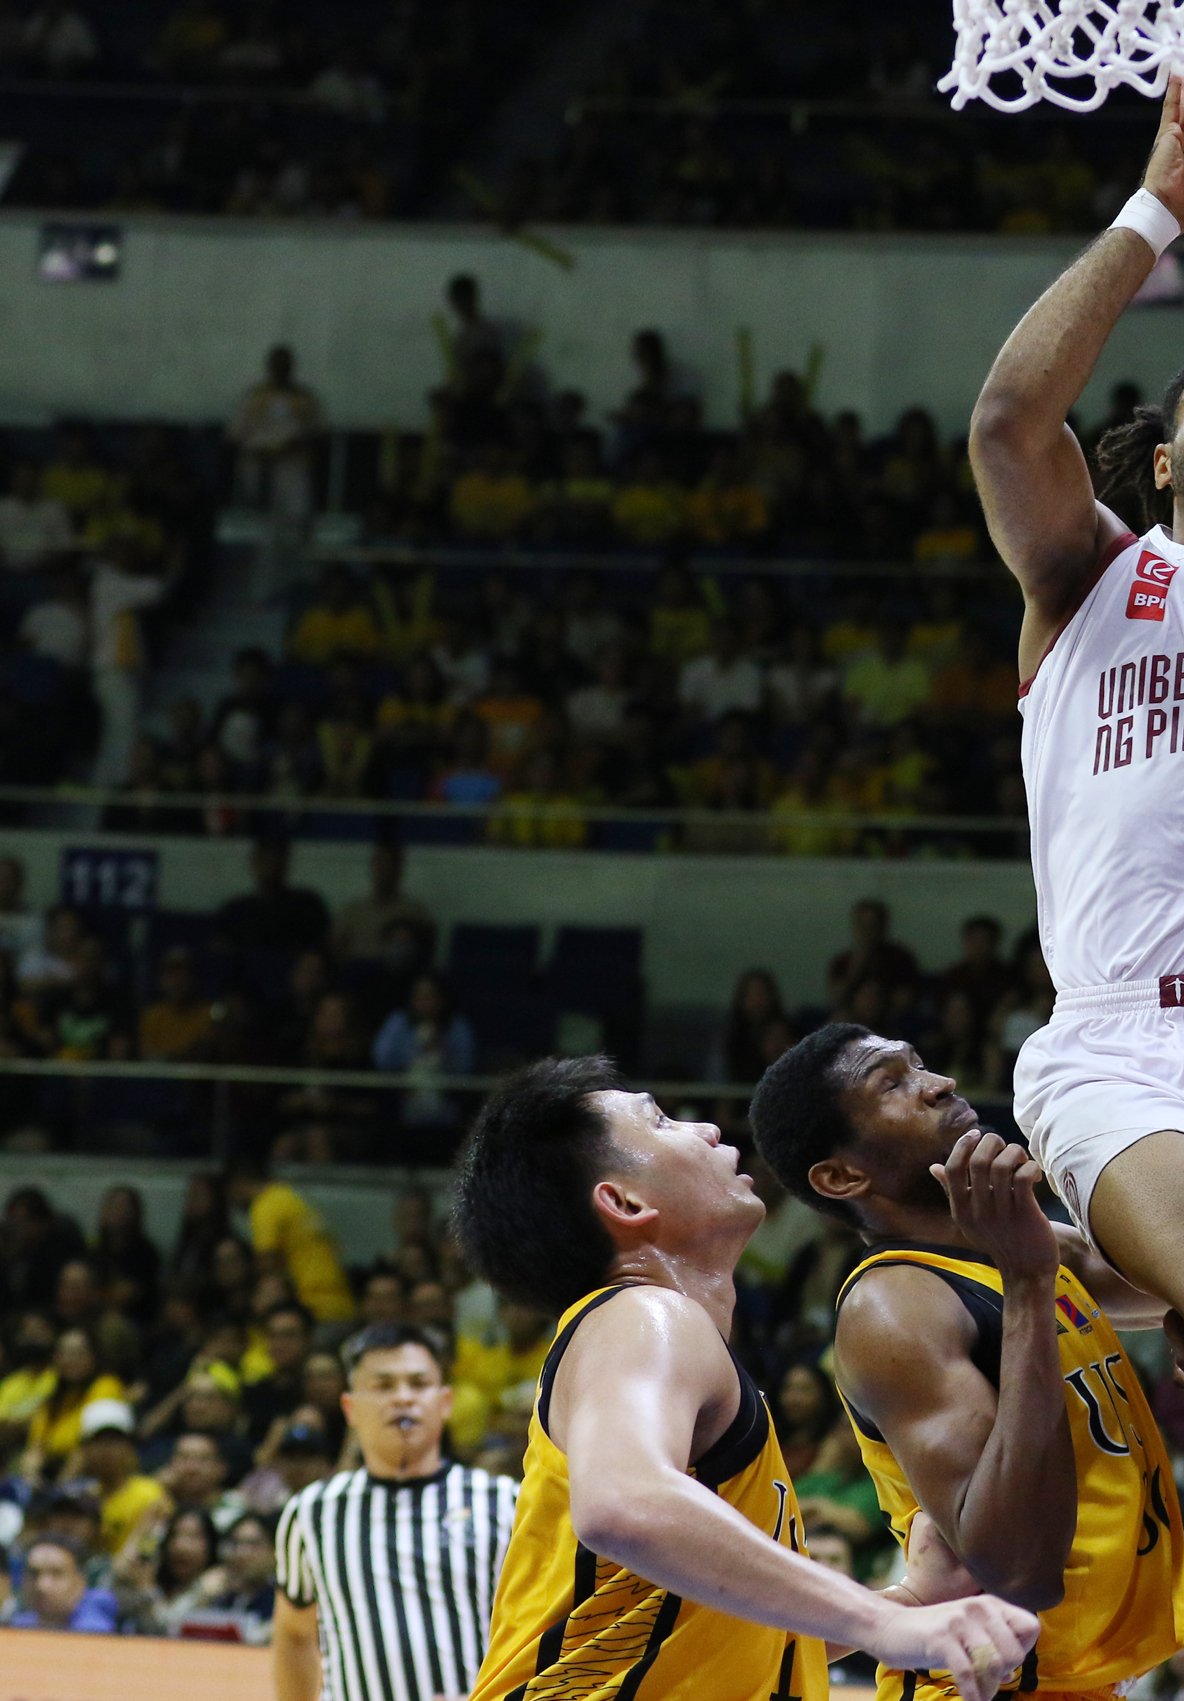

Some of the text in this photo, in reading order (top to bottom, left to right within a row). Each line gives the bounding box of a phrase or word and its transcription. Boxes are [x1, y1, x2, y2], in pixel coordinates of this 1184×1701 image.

[1135, 593, 1166, 609] BPI
[1093, 717, 1134, 776] NG
[72, 860, 150, 905] 112
